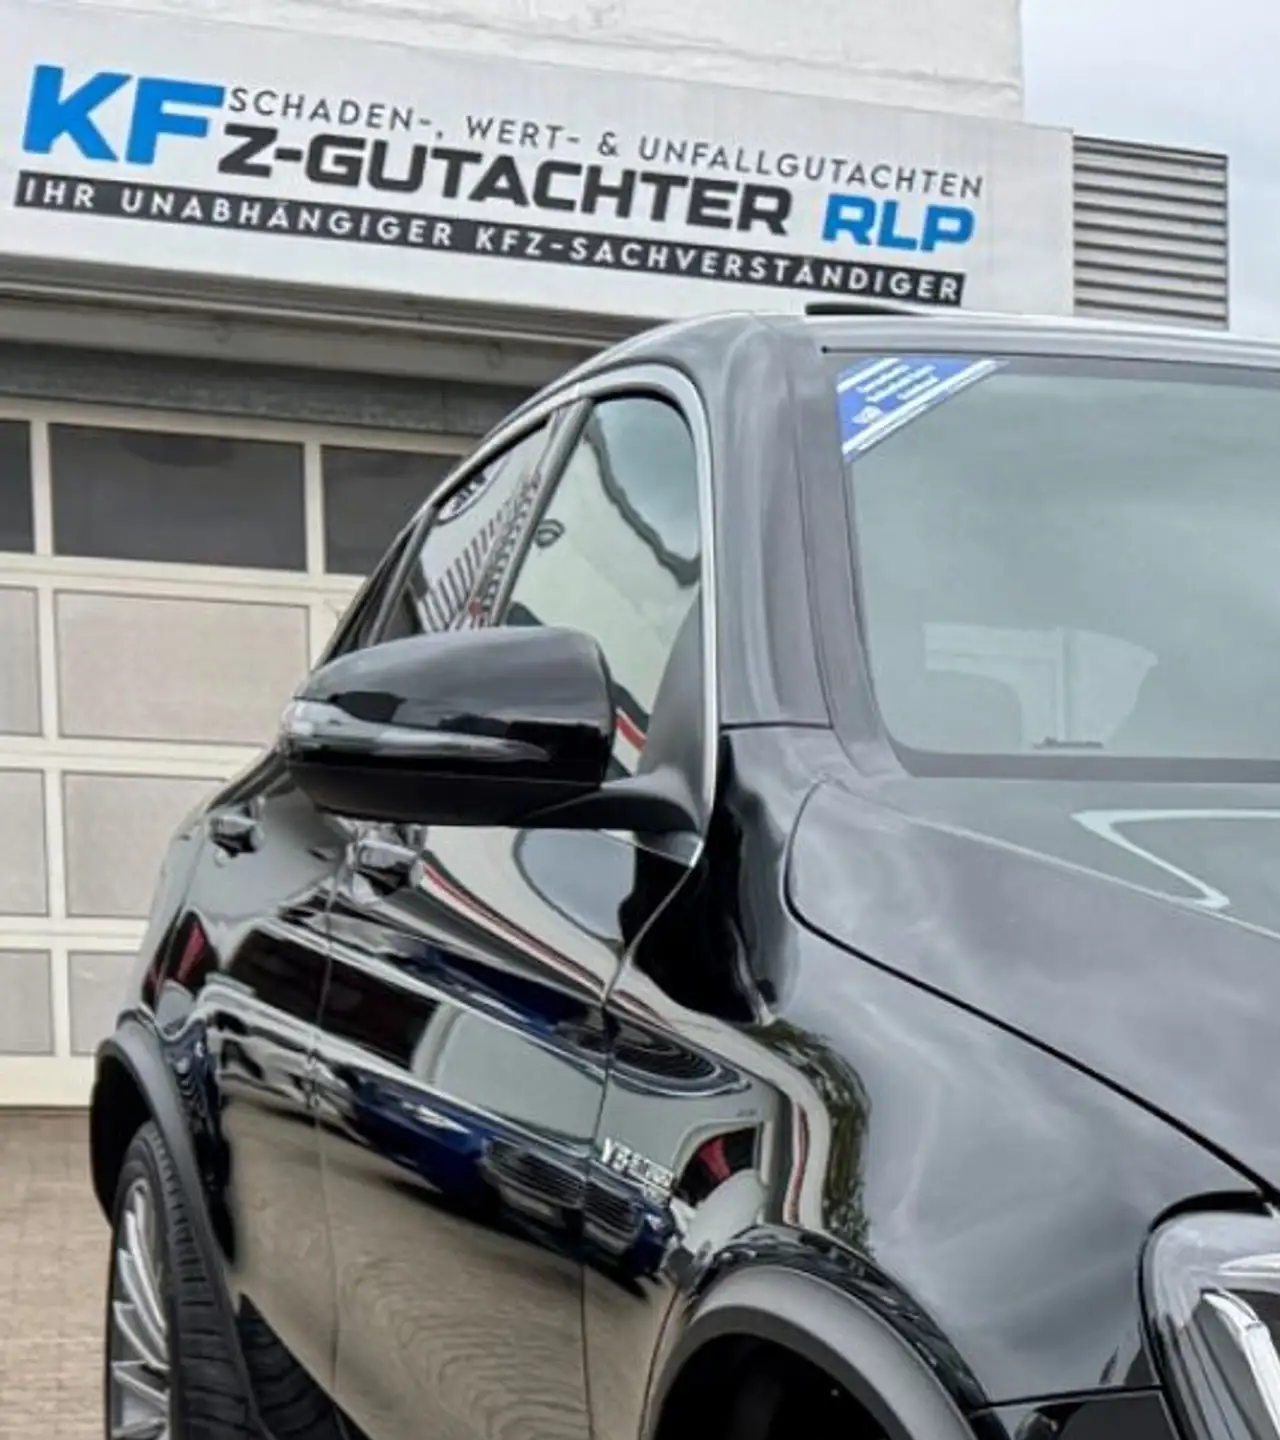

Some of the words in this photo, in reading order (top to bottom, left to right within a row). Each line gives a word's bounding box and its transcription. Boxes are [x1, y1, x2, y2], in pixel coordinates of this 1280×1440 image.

[229, 85, 445, 139] SCHADEN-,
[466, 115, 581, 151] WERT-
[599, 131, 620, 157] &
[637, 136, 984, 199] UNFALLGUTACHTEN
[24, 177, 95, 211] IHR
[121, 186, 454, 248] UNABHÄNGIGER
[474, 224, 959, 301] KFZ-SACHVERSTÄNDIGER
[822, 193, 976, 253] RLP
